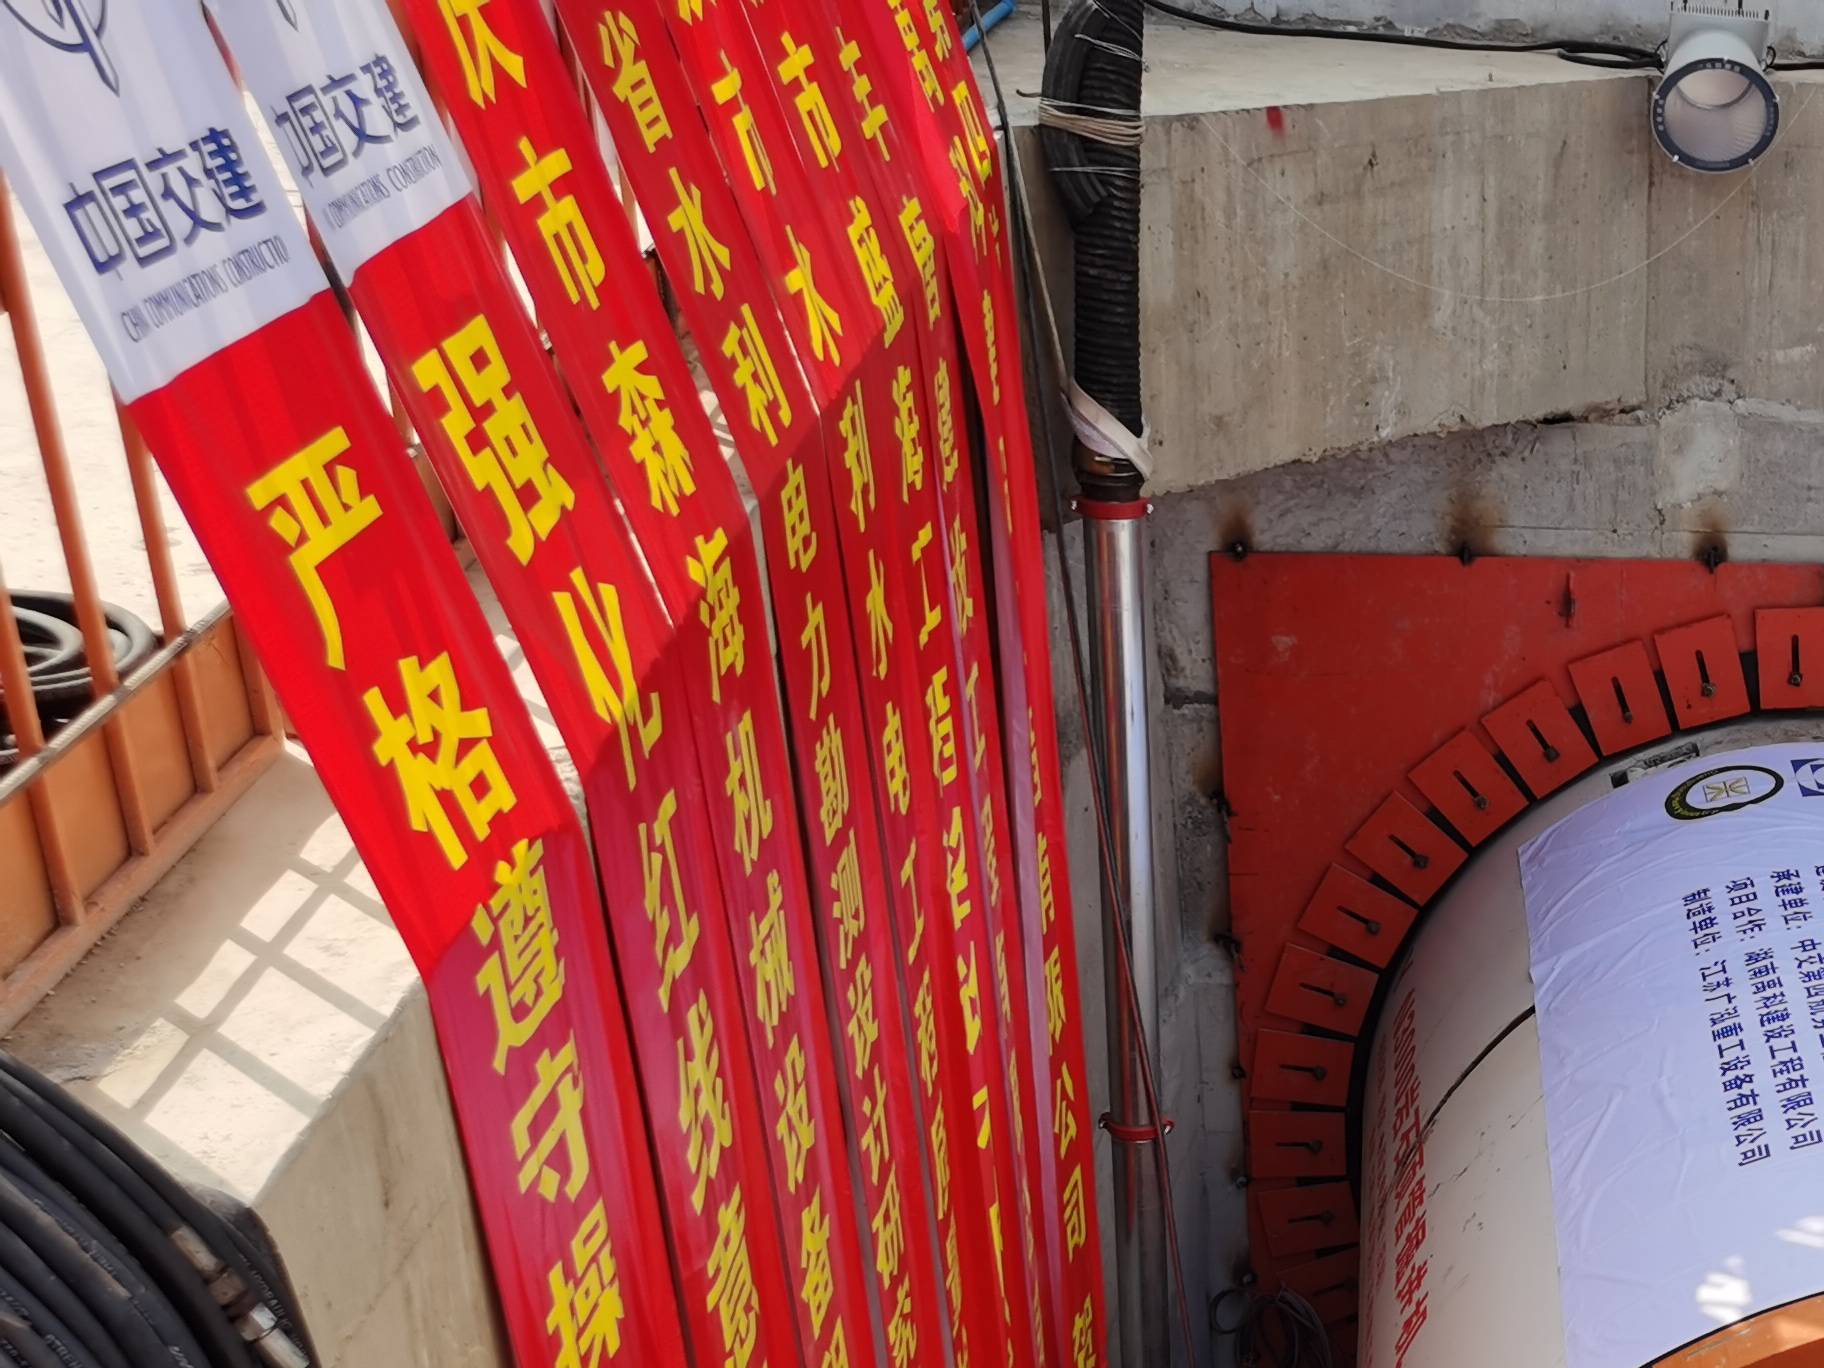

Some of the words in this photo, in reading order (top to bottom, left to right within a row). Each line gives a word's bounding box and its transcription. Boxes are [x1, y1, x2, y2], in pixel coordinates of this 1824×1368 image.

[272, 51, 422, 187] 中国交建
[64, 126, 268, 282] 中国交建
[1744, 948, 1824, 1152] 湖南高科建设工程有限公司
